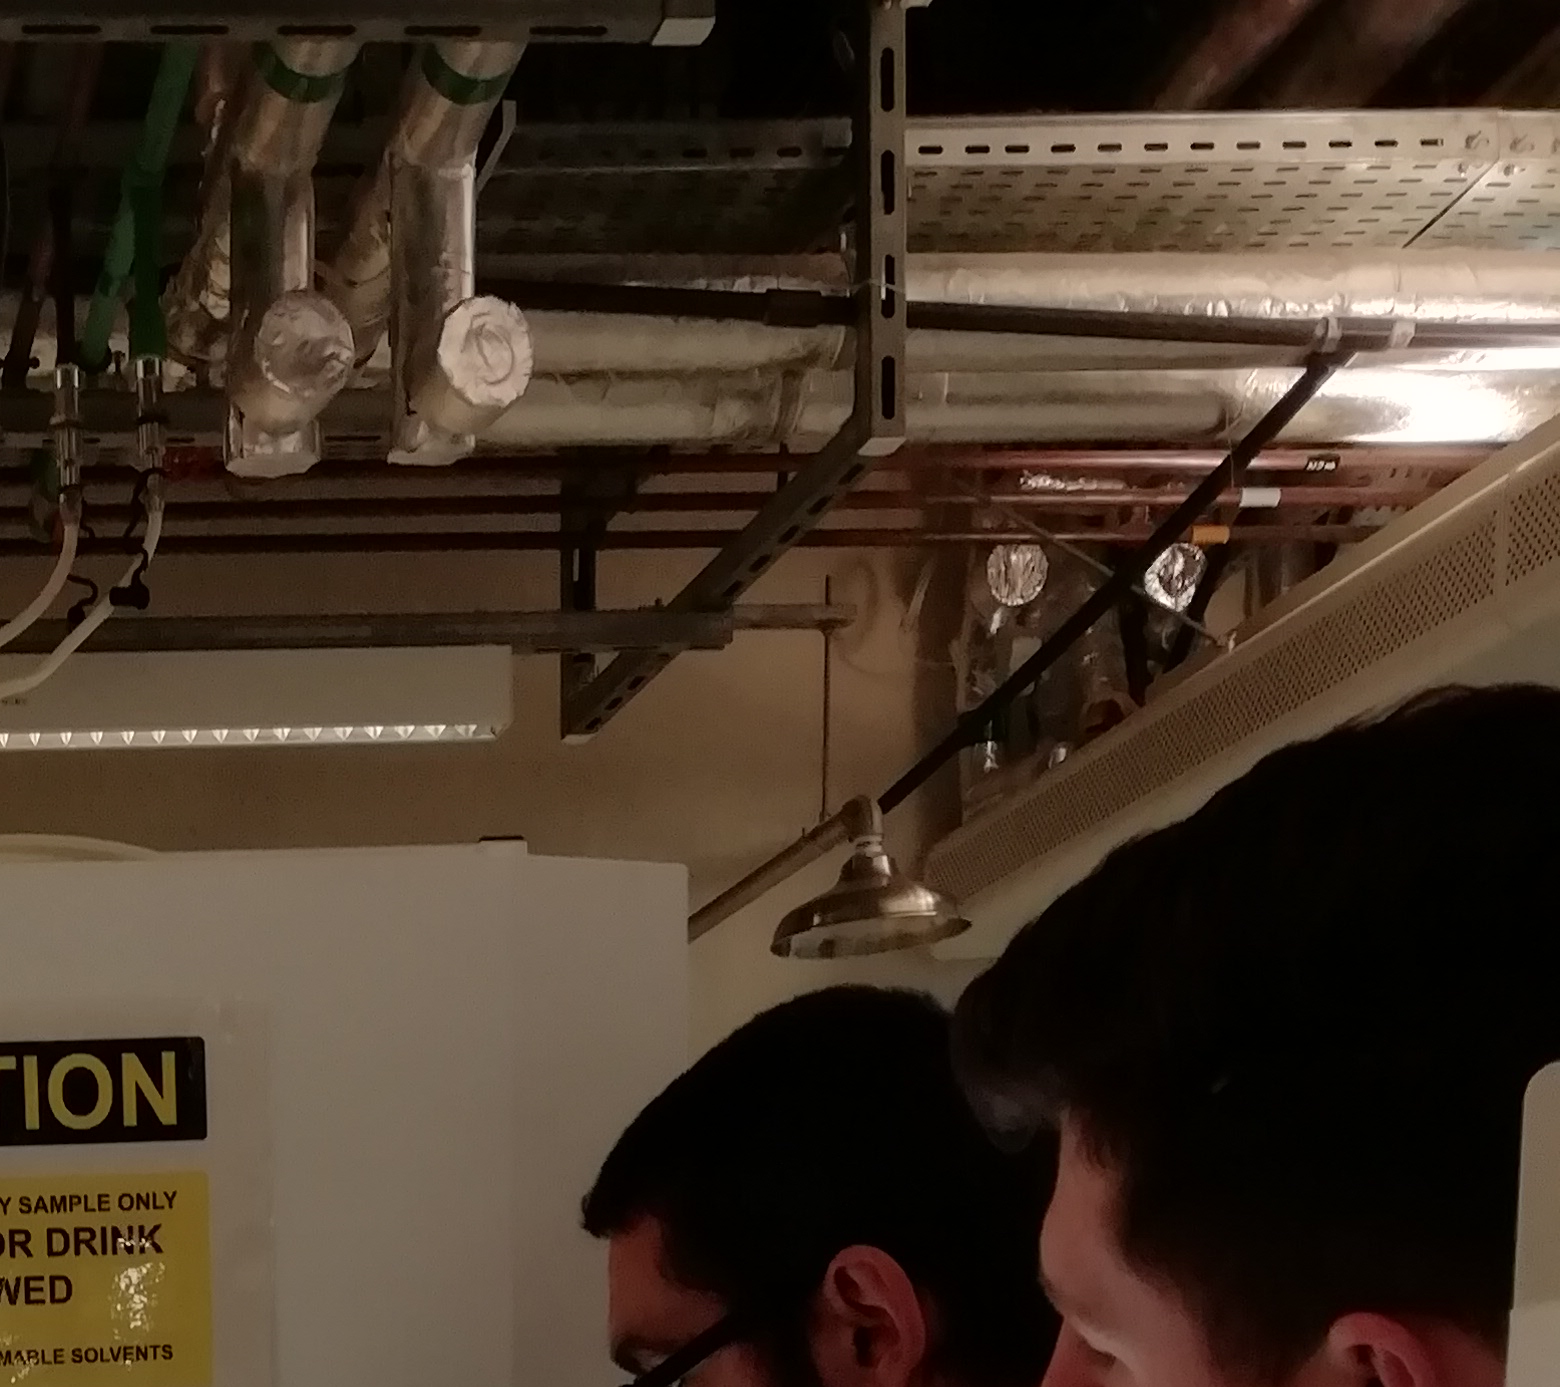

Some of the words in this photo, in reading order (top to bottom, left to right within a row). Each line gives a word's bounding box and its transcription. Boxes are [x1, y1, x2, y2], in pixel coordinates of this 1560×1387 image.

[19, 1193, 111, 1215] SAMPLE
[117, 1190, 178, 1211] ONLY
[46, 1223, 164, 1258] DRINK
[71, 1344, 174, 1364] SOLVENTS
